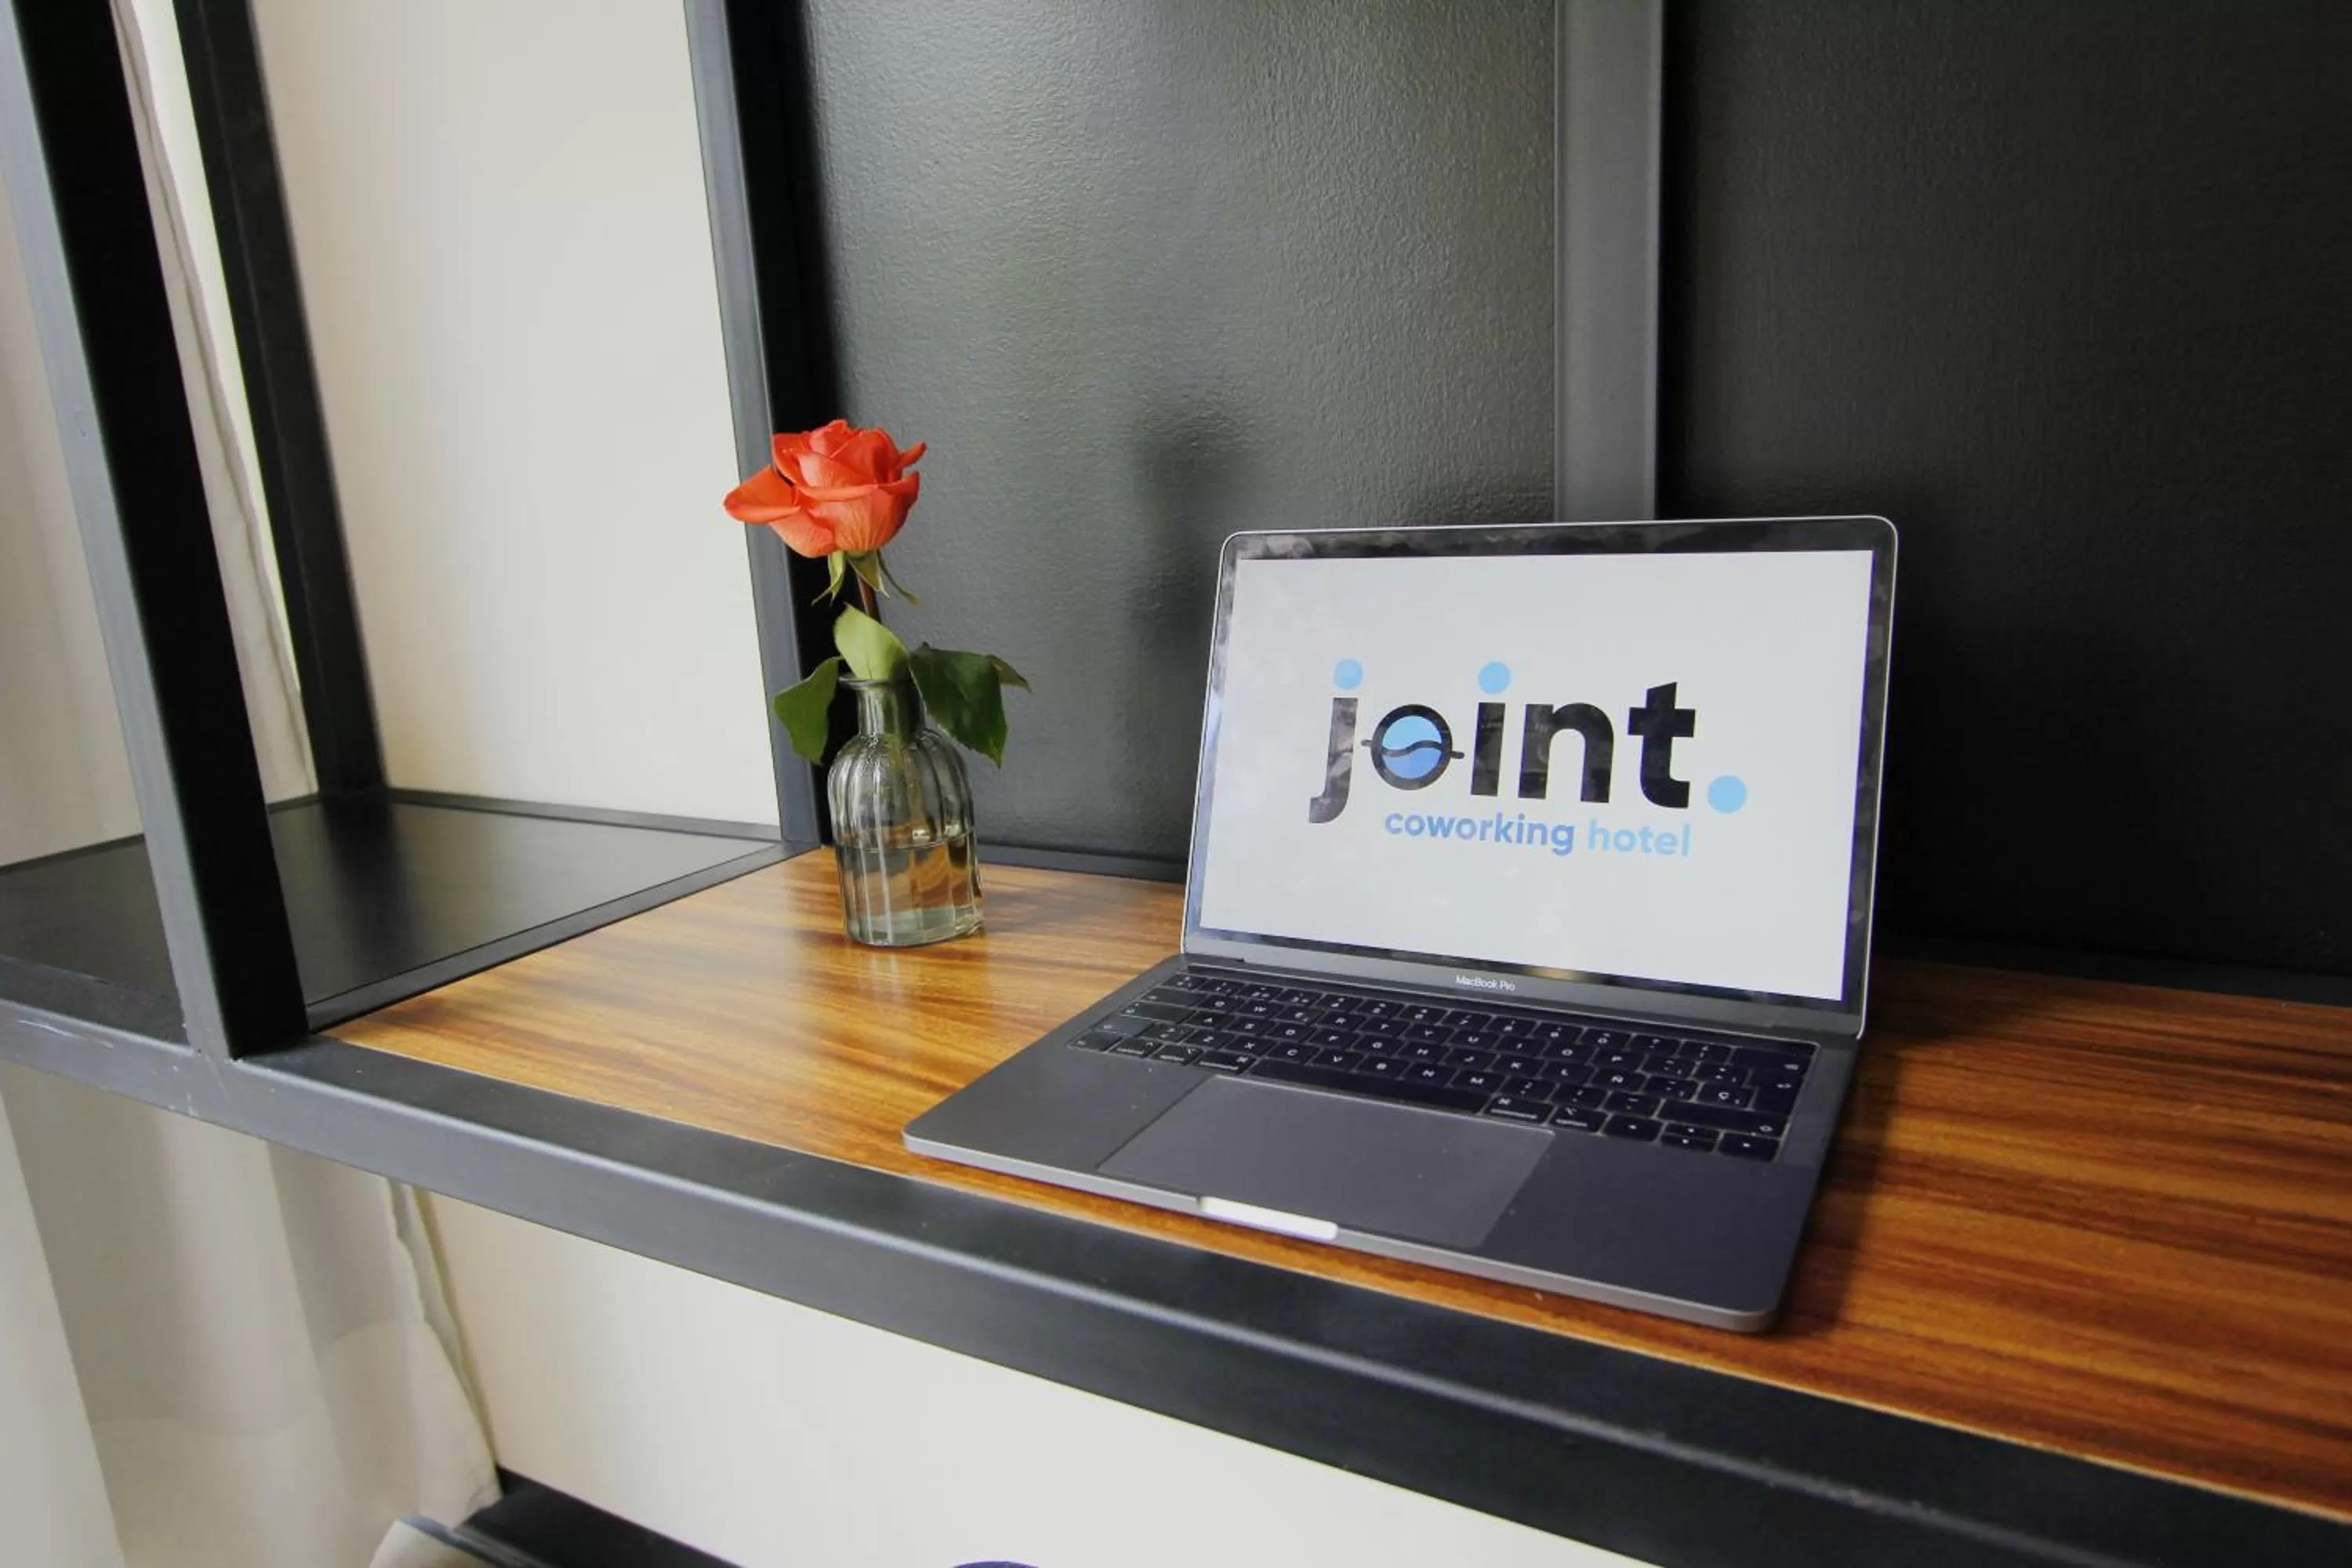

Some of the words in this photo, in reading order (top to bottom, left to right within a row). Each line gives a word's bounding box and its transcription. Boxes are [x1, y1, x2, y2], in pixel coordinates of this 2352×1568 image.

[1385, 809, 1577, 857] coworking
[1588, 817, 1693, 858] hotel
[1455, 975, 1497, 989] MacBook
[1499, 980, 1516, 992] Pro
